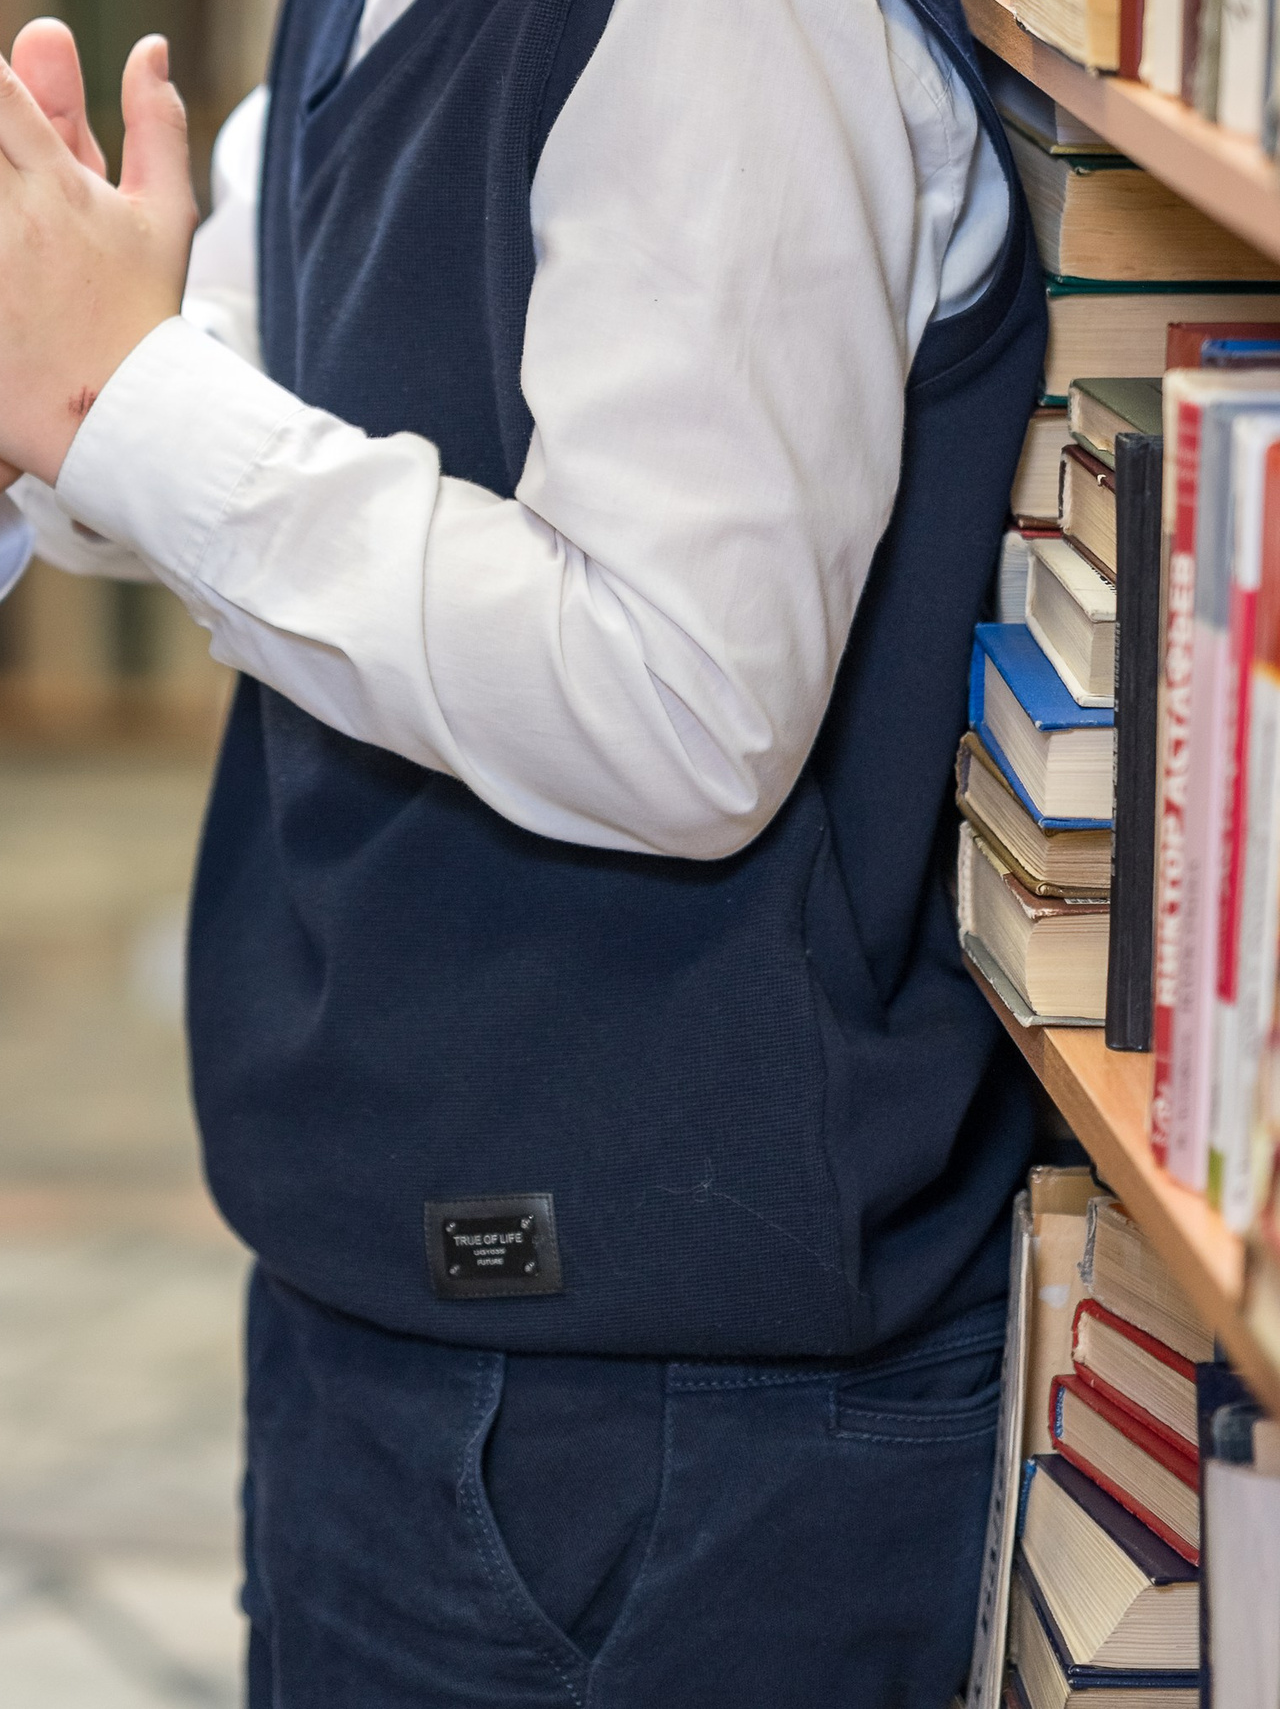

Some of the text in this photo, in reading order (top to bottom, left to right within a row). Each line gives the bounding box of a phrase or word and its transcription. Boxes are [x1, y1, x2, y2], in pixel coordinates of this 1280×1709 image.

[1159, 553, 1196, 1007] ВИКТОР АСТАФЬЕВ
[453, 1232, 523, 1246] TRUE OF LIFE
